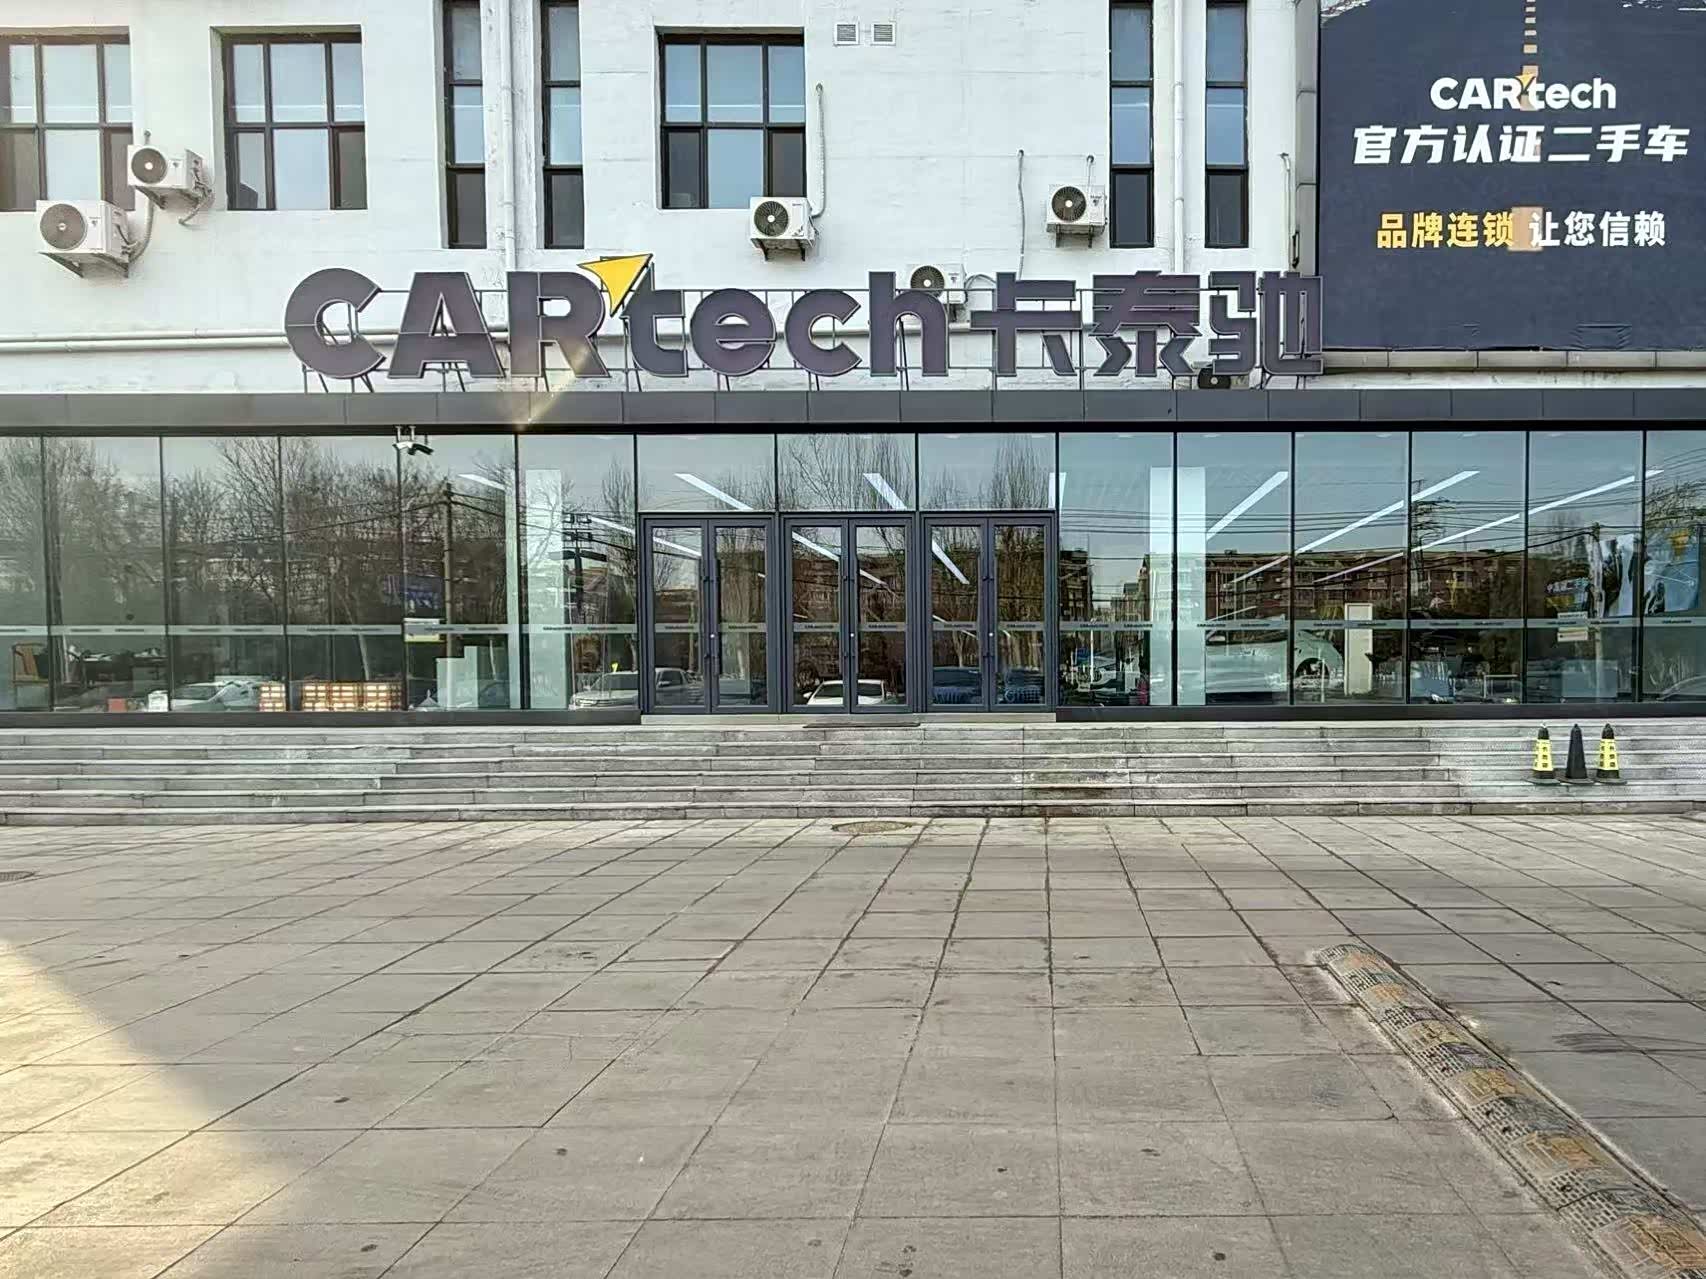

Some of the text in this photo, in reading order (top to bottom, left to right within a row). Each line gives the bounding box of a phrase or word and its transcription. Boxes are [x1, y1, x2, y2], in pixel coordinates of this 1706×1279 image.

[1430, 77, 1617, 110] CARtech
[1353, 124, 1690, 164] 官方认证二手车
[1376, 211, 1667, 249] 品牌连锁 让您信赖
[284, 266, 950, 379] CARtech
[970, 270, 1324, 377] 卡泰驰
